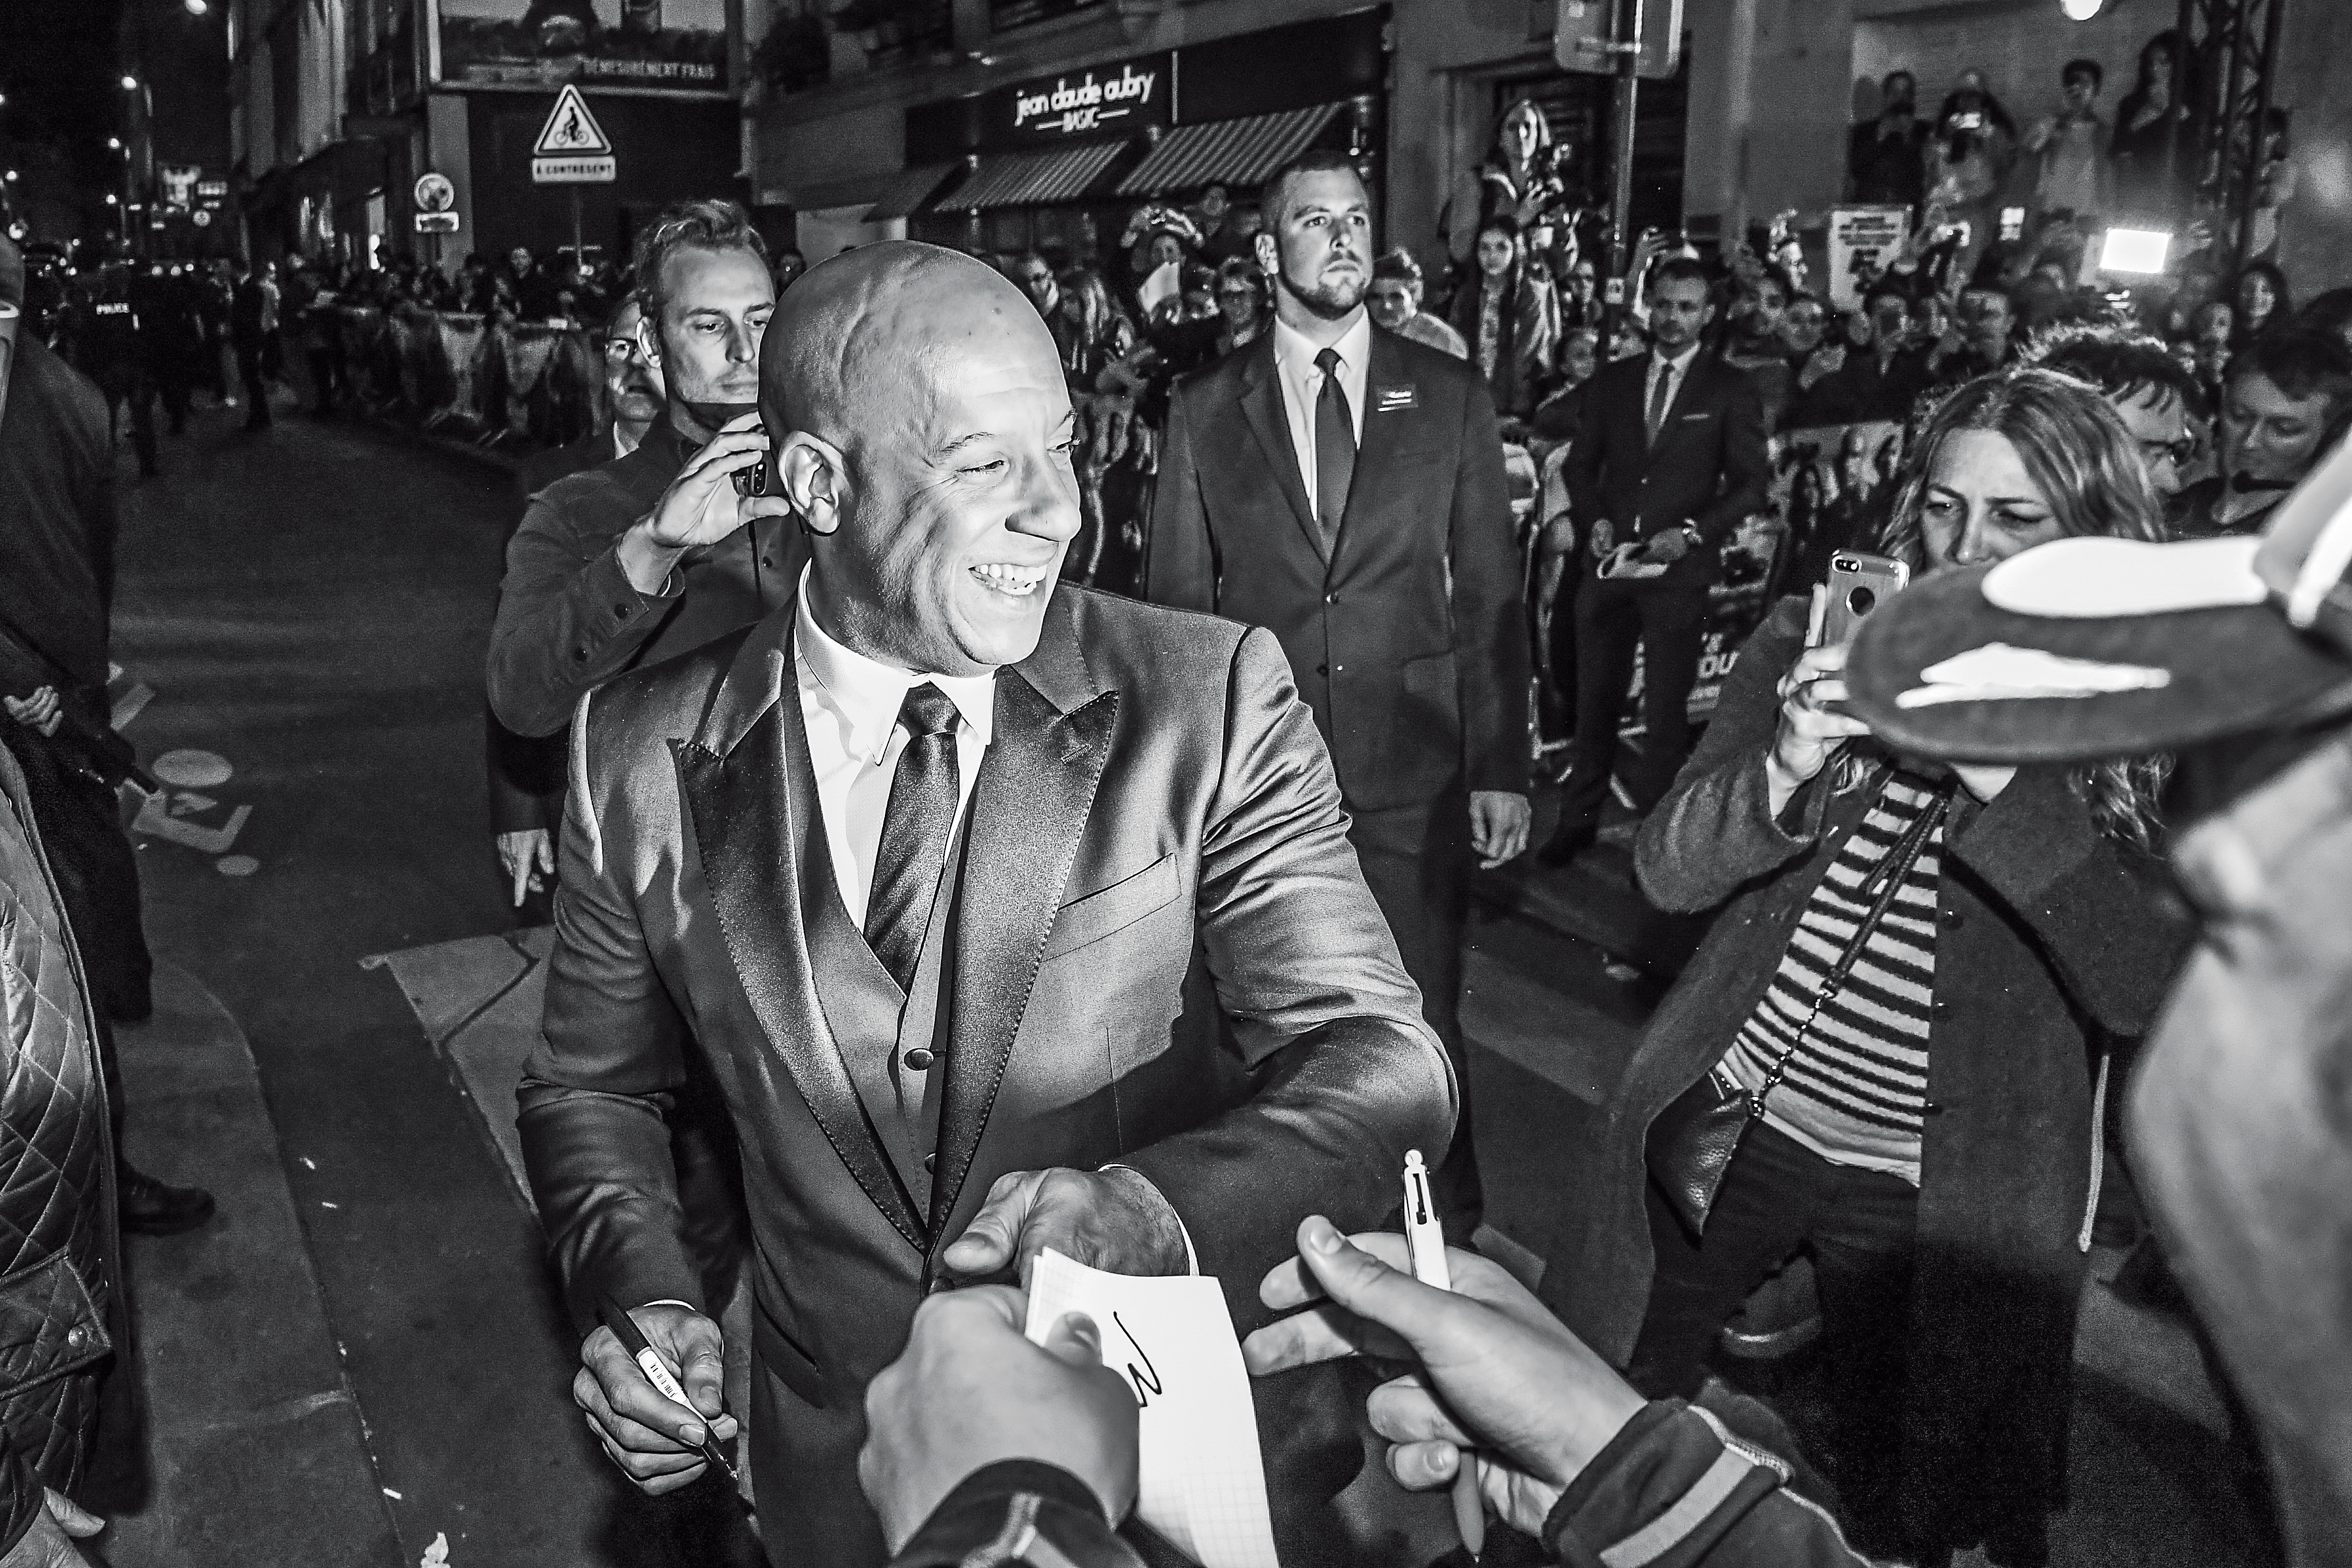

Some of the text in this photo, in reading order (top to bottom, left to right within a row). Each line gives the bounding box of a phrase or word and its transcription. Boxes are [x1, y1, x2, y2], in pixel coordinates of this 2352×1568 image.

[1015, 64, 1155, 126] jean claude aubry
